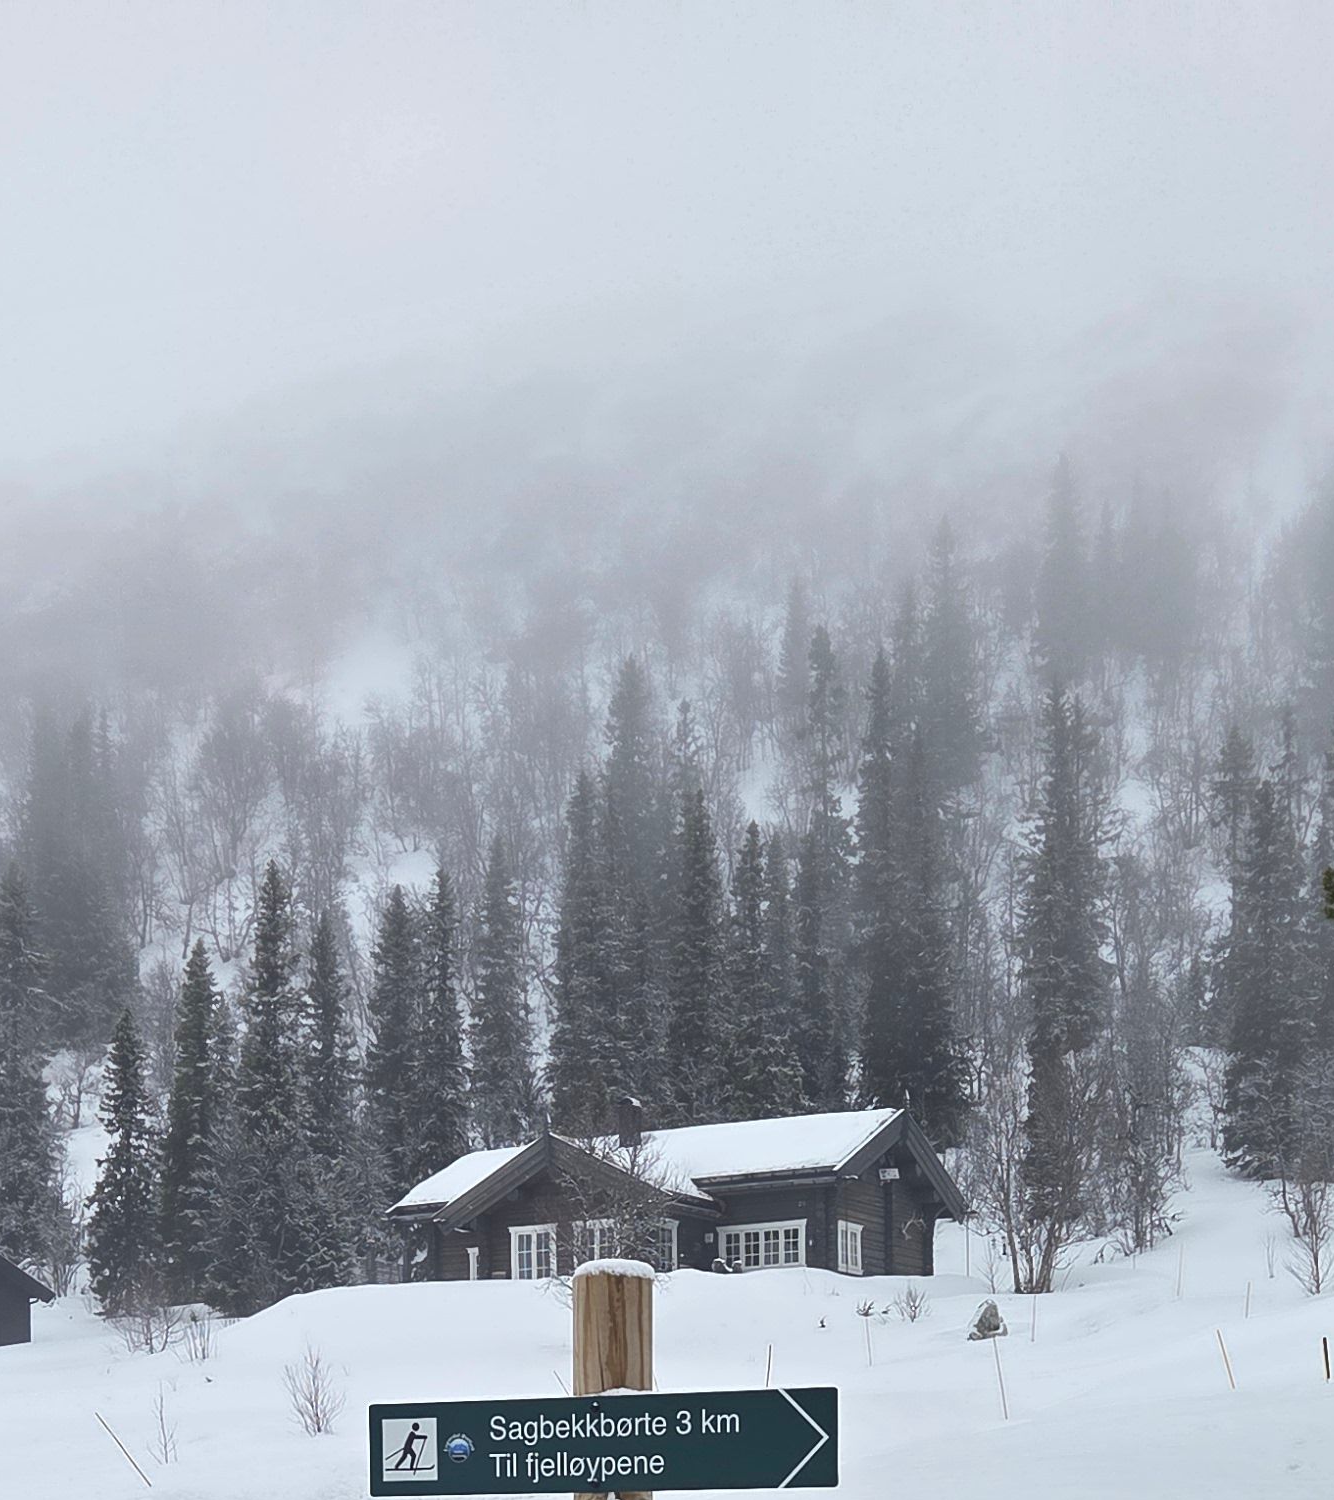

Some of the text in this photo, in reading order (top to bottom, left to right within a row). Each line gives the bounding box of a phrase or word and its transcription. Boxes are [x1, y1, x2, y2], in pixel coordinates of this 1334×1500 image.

[489, 1409, 740, 1446] Sagbekkbørte 3 km
[489, 1451, 665, 1483] Til fjelløypene
